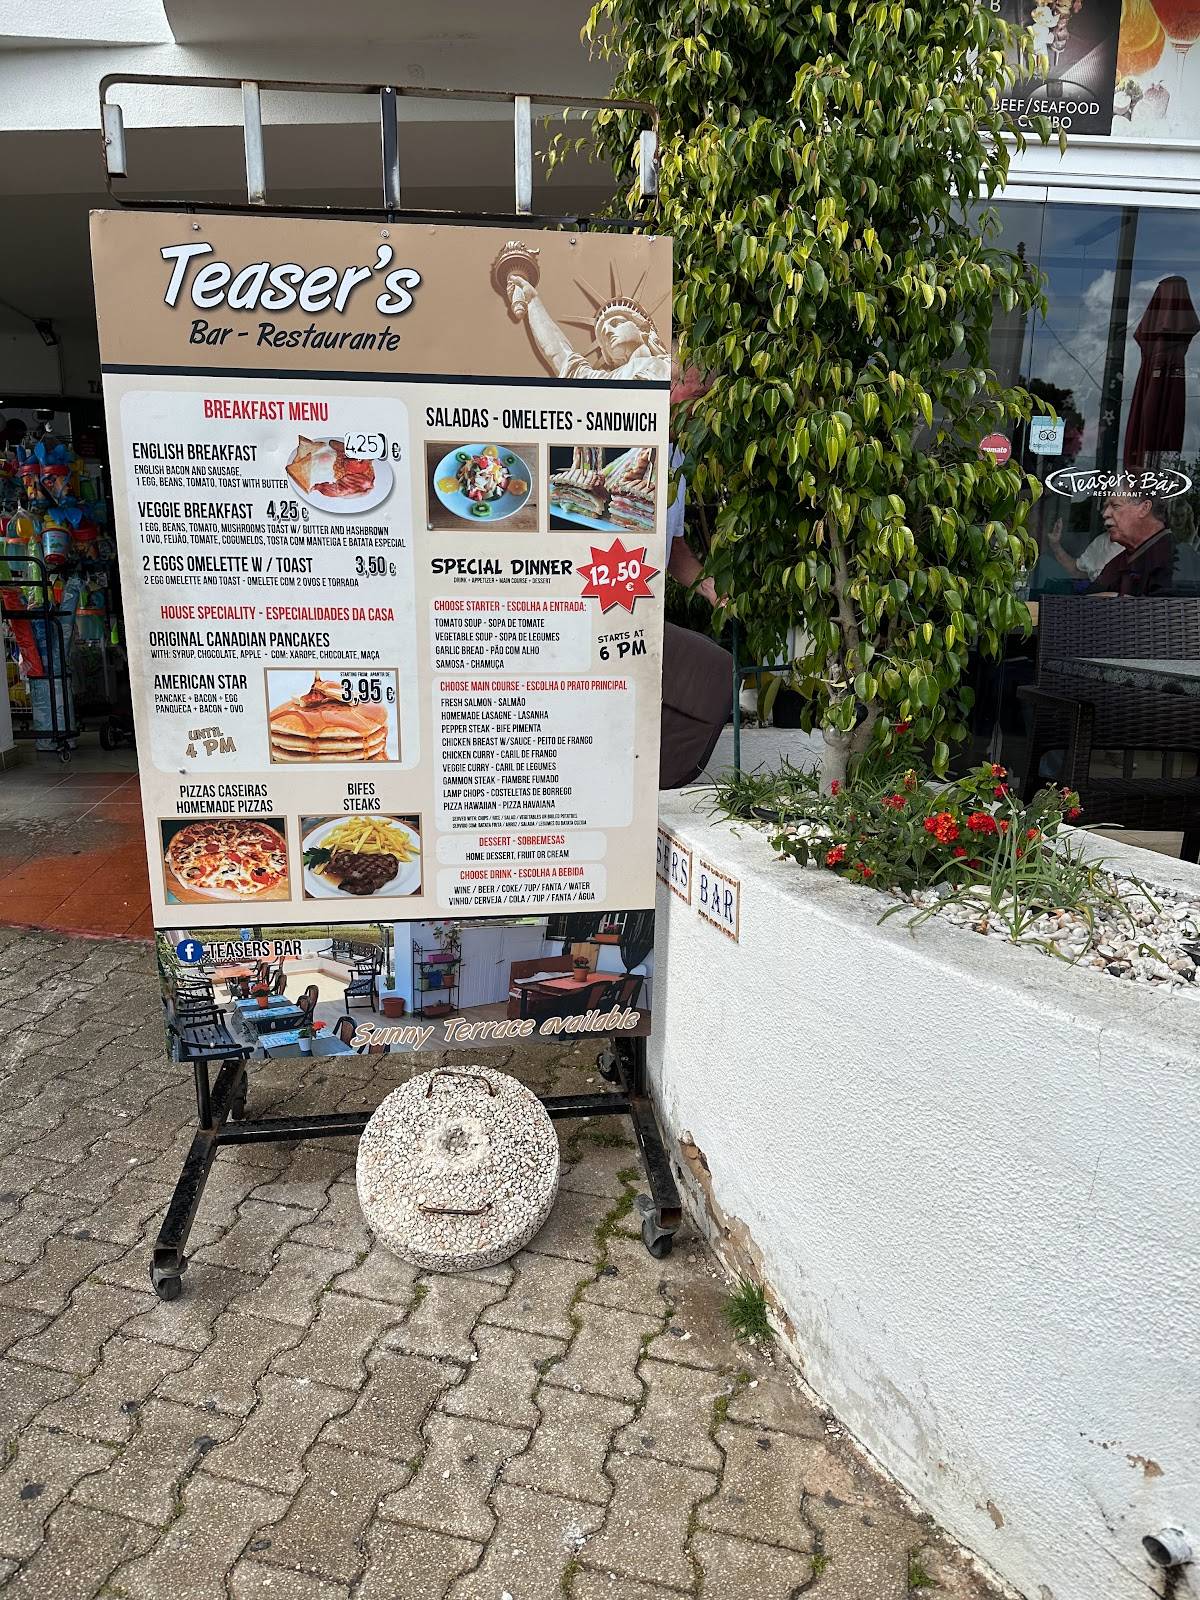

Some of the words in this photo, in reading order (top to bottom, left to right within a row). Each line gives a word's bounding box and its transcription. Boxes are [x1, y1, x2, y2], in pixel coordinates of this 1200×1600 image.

[160, 242, 421, 315] Teaser's
[189, 319, 234, 345] Bar
[257, 322, 401, 353] Restaurante
[204, 399, 284, 420] BREAKFAST
[289, 401, 328, 421] MENU
[426, 407, 488, 428] SALADAS
[502, 409, 572, 430] OMELETES
[586, 411, 657, 431] SANDWICH
[133, 443, 185, 460] ENGLISH
[187, 444, 257, 461] BREAKFAST
[135, 465, 164, 475] ENGLISH
[166, 466, 189, 476] BACON
[191, 467, 206, 476] AND
[208, 467, 241, 477] SAUSAGE,
[142, 477, 157, 487] EGG,
[159, 478, 184, 487] BEANS,
[186, 478, 216, 487] TOMATO,
[218, 478, 241, 488] TOAST
[243, 479, 261, 488] WITH
[262, 479, 288, 488] BUTTER
[1059, 470, 1135, 493] Teaser's
[1141, 471, 1179, 494] Bar
[138, 502, 181, 518] VEGGIE
[184, 503, 253, 519] BREAKFAST
[267, 501, 299, 522] 4,25
[162, 523, 187, 533] BEANS,
[189, 524, 219, 533] TOMATO,
[221, 524, 265, 533] MUSHROOMS
[268, 525, 289, 534] TOAST
[303, 525, 329, 534] BUTTER
[330, 525, 344, 534] AND
[346, 526, 388, 535] HASHBROWN
[154, 556, 183, 571] EGGS
[187, 556, 249, 572] OMELETTE
[276, 557, 313, 573] TOAST
[356, 556, 388, 577] 3,50
[431, 559, 502, 575] SPECIAL
[511, 560, 573, 575] DINNER
[590, 560, 640, 587] 12,50
[435, 601, 464, 611] CHOOSE
[466, 601, 499, 611] STARTER
[507, 601, 541, 611] ESCOLHA
[550, 601, 586, 611] ENTRADA:
[161, 605, 195, 619] HOUSE
[198, 606, 255, 620] SPECIALITY
[266, 607, 349, 620] ESPECIALIDADES
[368, 608, 394, 621] CASA
[435, 619, 462, 627] TOMATO
[465, 619, 482, 627] SOUP
[488, 619, 506, 627] SOPA
[518, 619, 544, 627] TOMATE
[150, 632, 204, 646] ORIGINAL
[207, 632, 266, 647] CANADIAN
[270, 633, 329, 647] PANCAKES
[435, 633, 474, 641] VEGETABLE
[476, 633, 493, 641] SOUP
[499, 633, 517, 641] SOPA
[529, 633, 559, 641] LEGUMES
[598, 631, 630, 643] STARTS
[436, 646, 460, 654] GARLIC
[462, 646, 484, 654] BREAD
[491, 645, 503, 654] PÃO
[506, 646, 520, 654] COM
[522, 646, 539, 654] ALHO
[599, 646, 609, 660] 6
[617, 639, 647, 658] PM
[436, 660, 464, 668] SAMOSA
[471, 660, 504, 669] CHAMUÇA
[154, 675, 215, 689] AMERICAN
[218, 675, 247, 689] STAR
[441, 681, 469, 691] CHOOSE
[471, 681, 490, 691] MAIN
[492, 681, 519, 691] COURSE
[526, 681, 558, 690] ESCOLHA
[567, 681, 589, 690] PRATO
[591, 681, 627, 690] PRINCIPAL
[155, 694, 186, 702] PANCAKE
[194, 694, 217, 702] BACON
[225, 694, 238, 702] EGG
[341, 679, 381, 706] 3,95
[156, 704, 191, 713] PANQUECA
[200, 704, 223, 713] BACON
[230, 704, 243, 713] OVO
[441, 699, 462, 707] FRESH
[464, 698, 492, 707] SALMON
[499, 697, 525, 706] SALMÃO
[441, 711, 480, 720] HOMEMADE
[482, 711, 511, 720] LASAGNE
[518, 711, 548, 719] LASANHA
[189, 726, 224, 741] UNTIL
[442, 725, 467, 733] PEPPER
[469, 724, 490, 733] STEAK
[496, 724, 511, 732] BIFE
[513, 724, 541, 732] PIMENTA
[203, 737, 236, 756] PM
[442, 738, 471, 746] CHICKEN
[473, 737, 498, 746] BREAST
[500, 737, 531, 745] W/SAUCE
[537, 737, 555, 745] PEITO
[567, 736, 592, 745] FRANGO
[442, 751, 471, 759] CHICKEN
[473, 750, 494, 759] CURRY
[501, 750, 520, 758] CARIL
[532, 750, 557, 758] FRANGO
[443, 764, 466, 772] VEGGIE
[468, 764, 489, 772] CURRY
[496, 763, 514, 771] CARIL
[526, 763, 556, 771] LEGUMES
[443, 776, 473, 785] GAMMON
[474, 776, 495, 784] STEAK
[502, 776, 530, 784] FIAMBRE
[532, 775, 558, 783] FUMADO
[180, 785, 215, 797] PIZZAS
[218, 784, 267, 797] CASEIRAS
[348, 782, 374, 795] BIFES
[443, 789, 461, 797] LAMP
[463, 789, 484, 797] CHOPS
[491, 788, 530, 797] COSTELETAS
[543, 787, 572, 796] BORREGO
[177, 800, 235, 813] HOMEMADE
[238, 800, 273, 812] PIZZAS
[343, 798, 380, 811] STEAKS
[443, 802, 462, 811] PIZZA
[464, 801, 496, 810] HAWAIIAN
[503, 801, 521, 809] PIZZA
[523, 800, 555, 809] HAVAIANA
[479, 837, 511, 847] DESSERT
[517, 836, 565, 846] SOBREMESAS
[466, 852, 484, 861] HOME
[486, 851, 516, 860] DESSERT,
[517, 851, 535, 859] FRUIT
[547, 850, 569, 858] CREAM
[460, 870, 488, 880] CHOOSE
[490, 869, 512, 879] DRINK
[518, 868, 550, 878] ESCOLHA
[559, 867, 583, 877] BEBIDA
[700, 874, 734, 925] BAR
[209, 941, 271, 960] TEASERS
[274, 940, 302, 957] BAR
[350, 1020, 433, 1051] Sunny
[444, 1016, 533, 1041] Terrace
[540, 1004, 640, 1034] available
